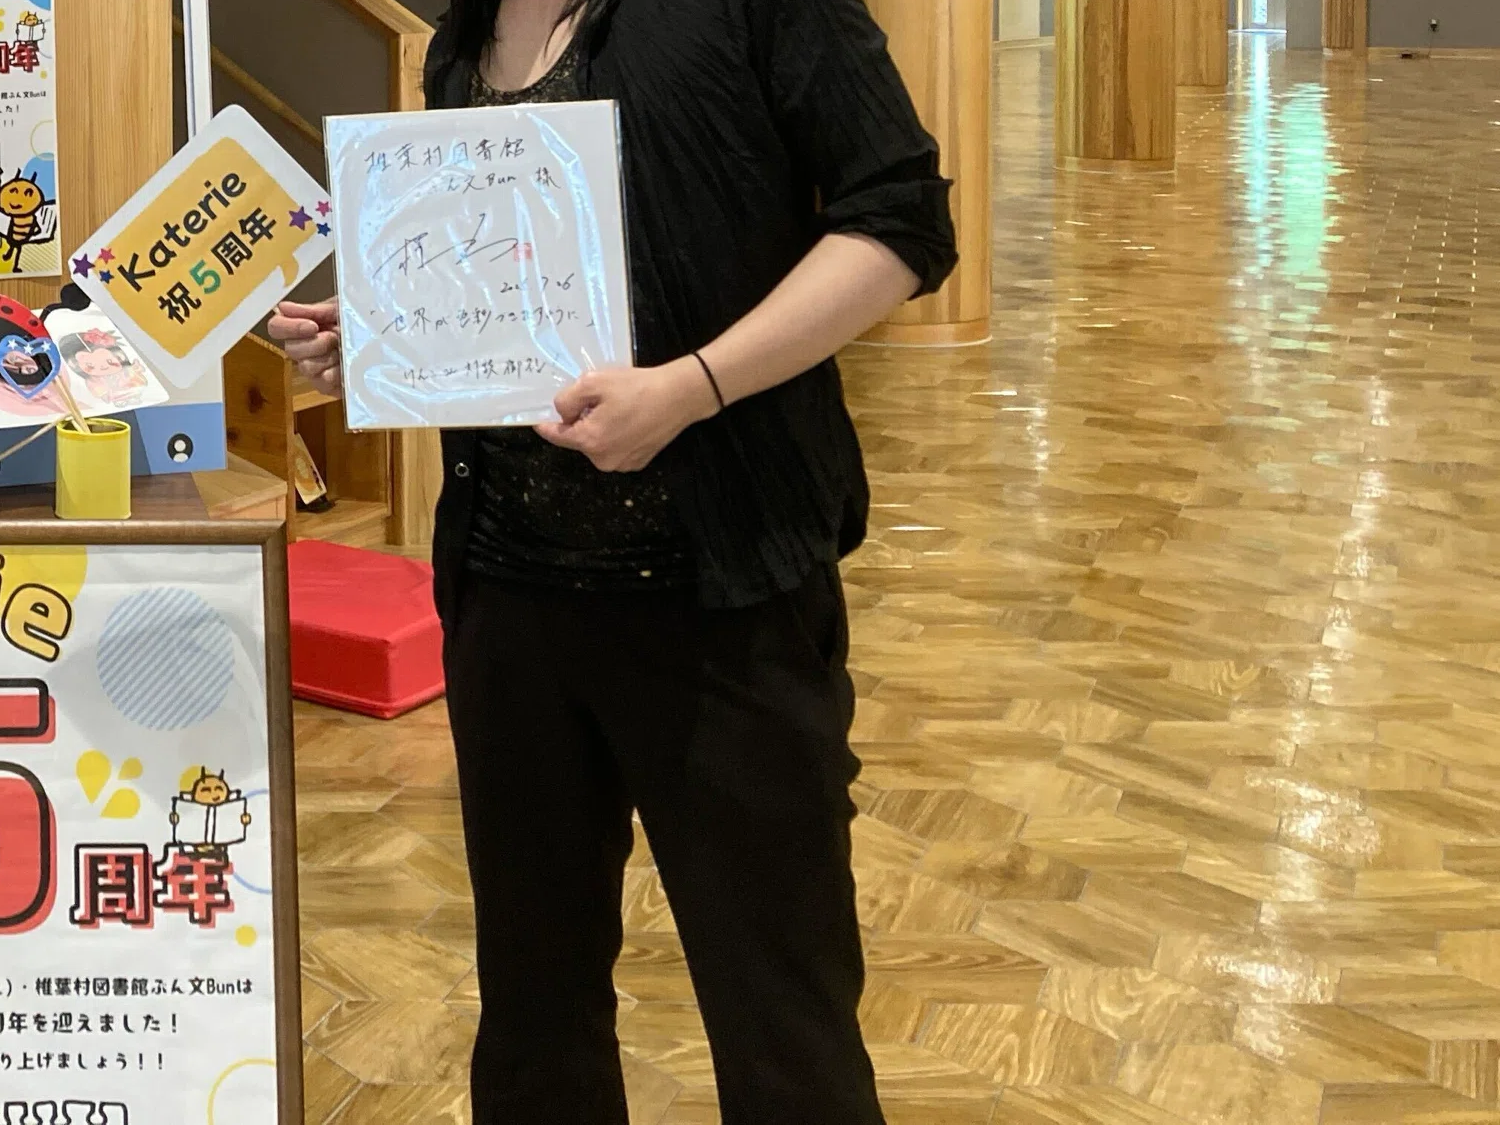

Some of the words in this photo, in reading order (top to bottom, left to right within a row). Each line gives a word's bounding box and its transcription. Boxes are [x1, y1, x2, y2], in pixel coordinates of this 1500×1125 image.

[117, 172, 247, 293] Katerie
[156, 207, 277, 325] 祝5周年
